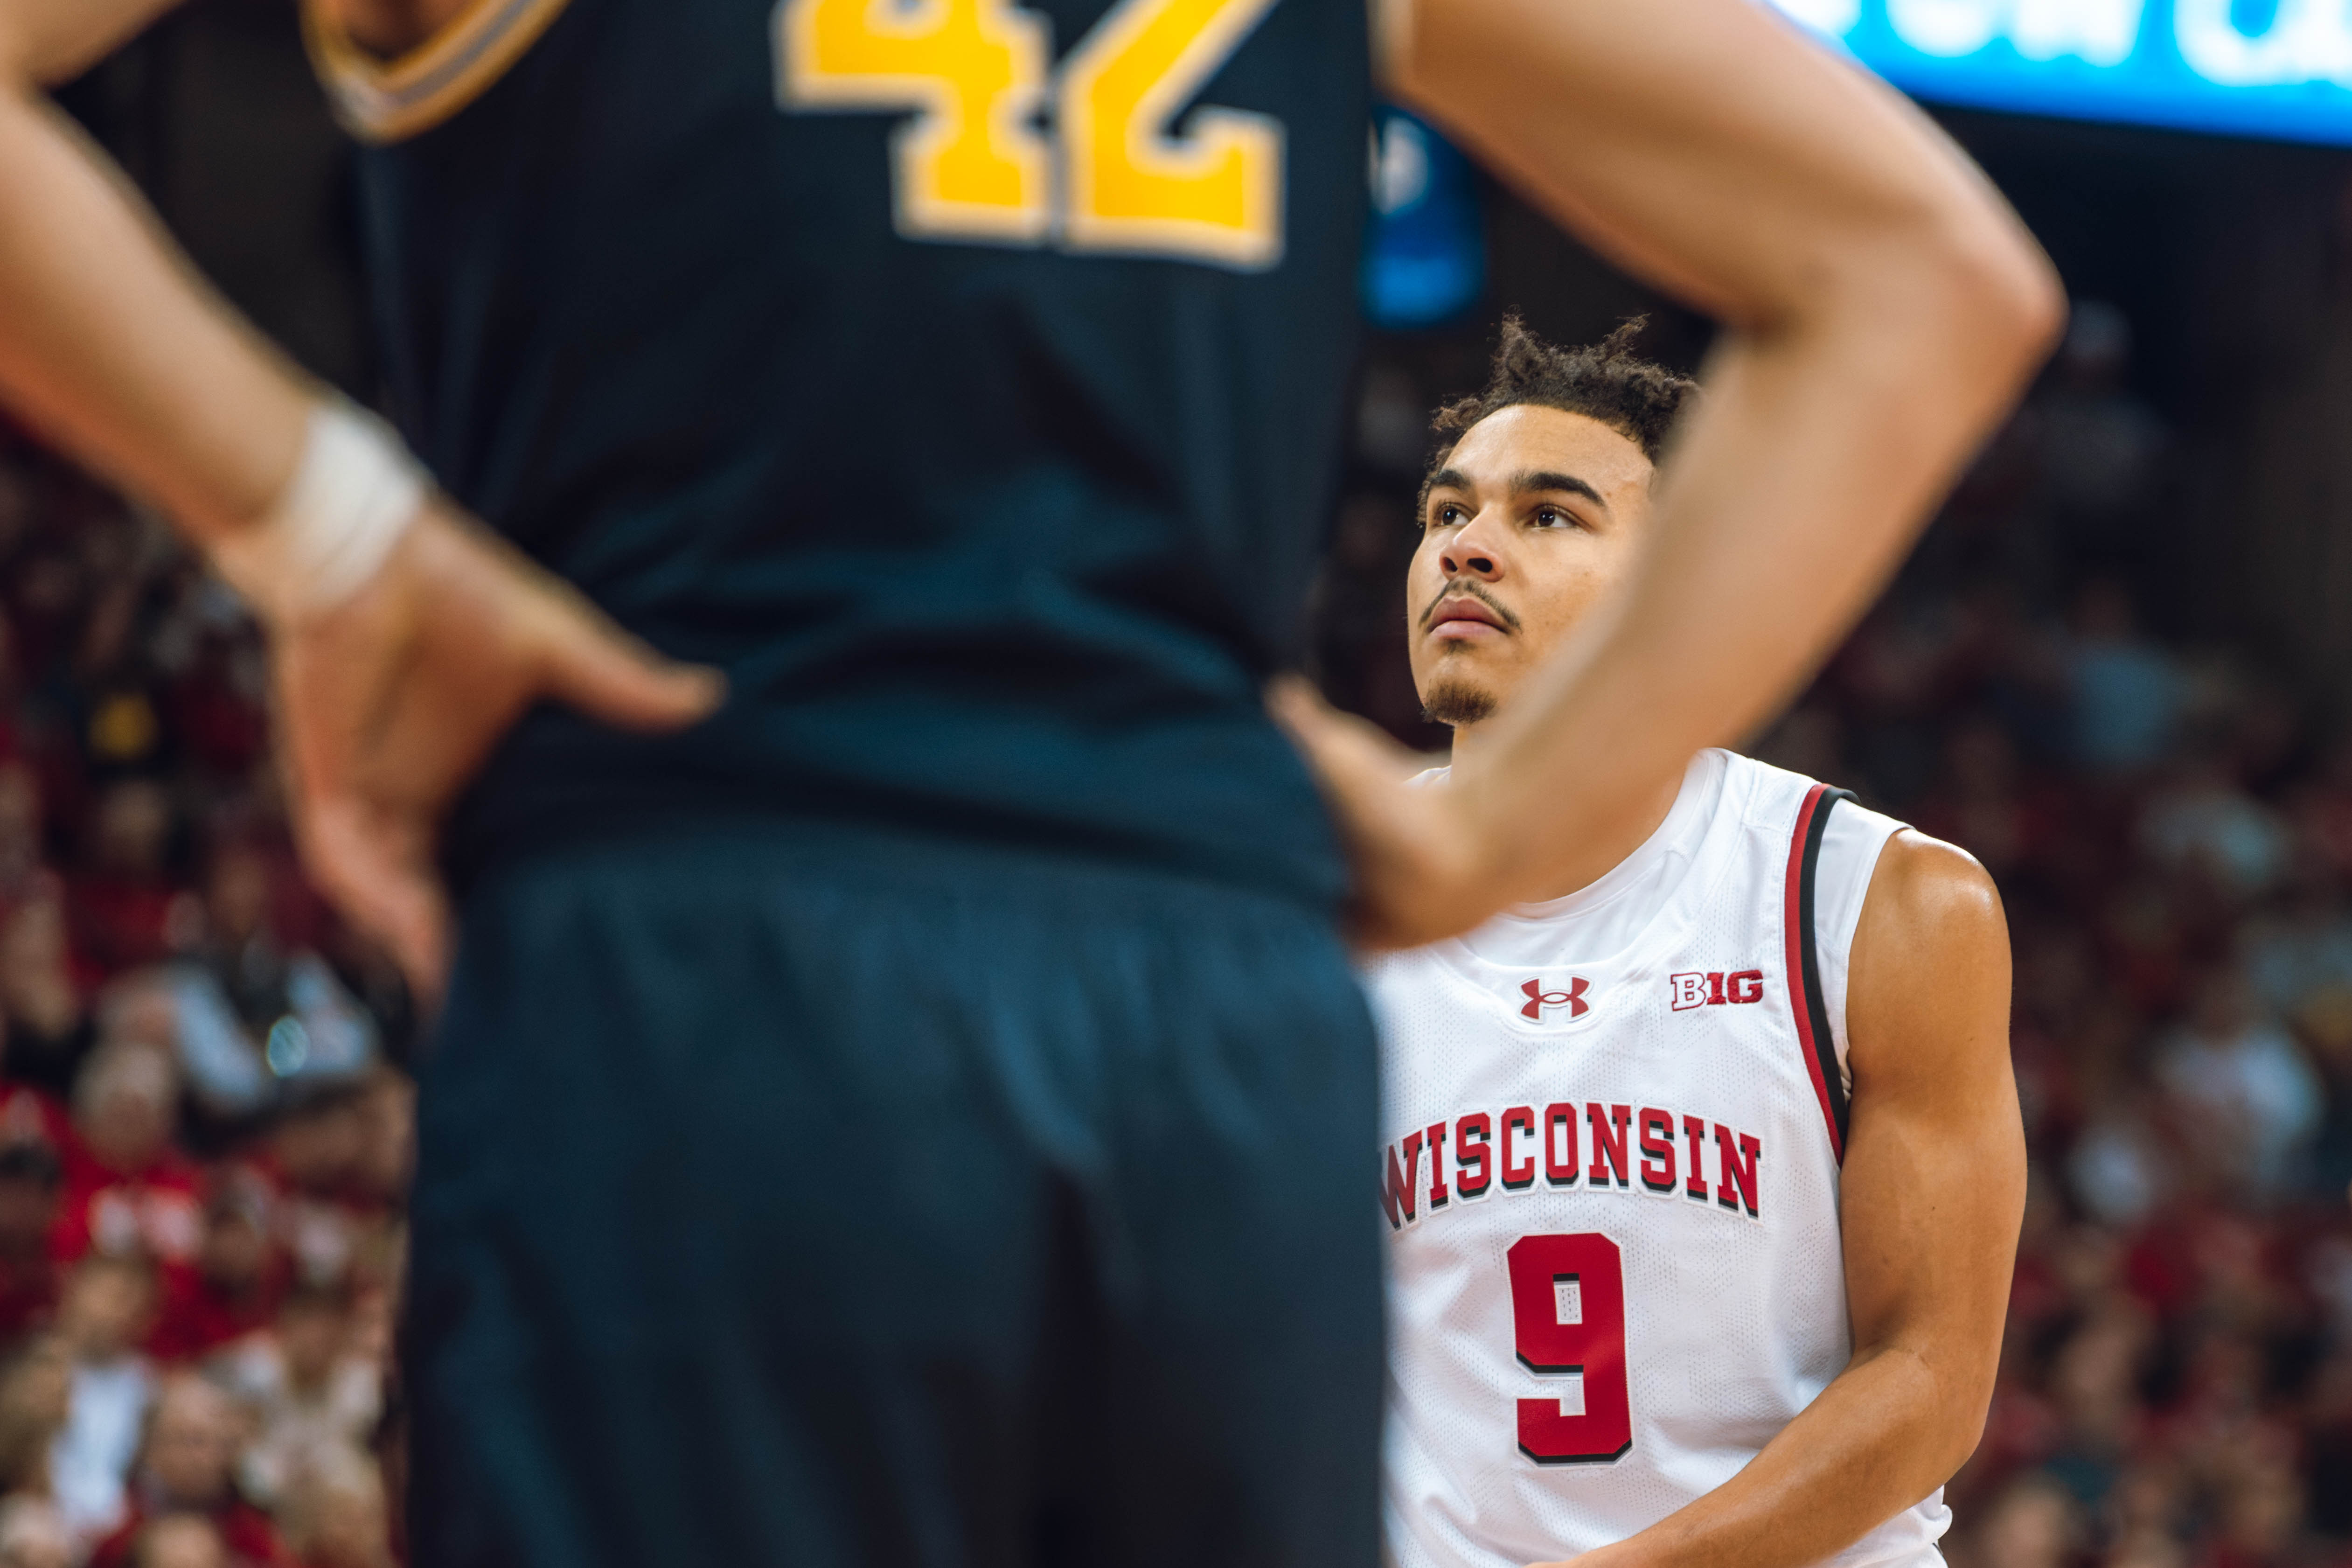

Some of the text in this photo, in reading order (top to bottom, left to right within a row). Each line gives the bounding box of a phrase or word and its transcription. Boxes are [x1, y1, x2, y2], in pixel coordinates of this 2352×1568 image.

[772, 0, 1285, 270] 42
[1379, 1102, 1761, 1230] WISCONSIN
[1507, 1233, 1633, 1467] 9
